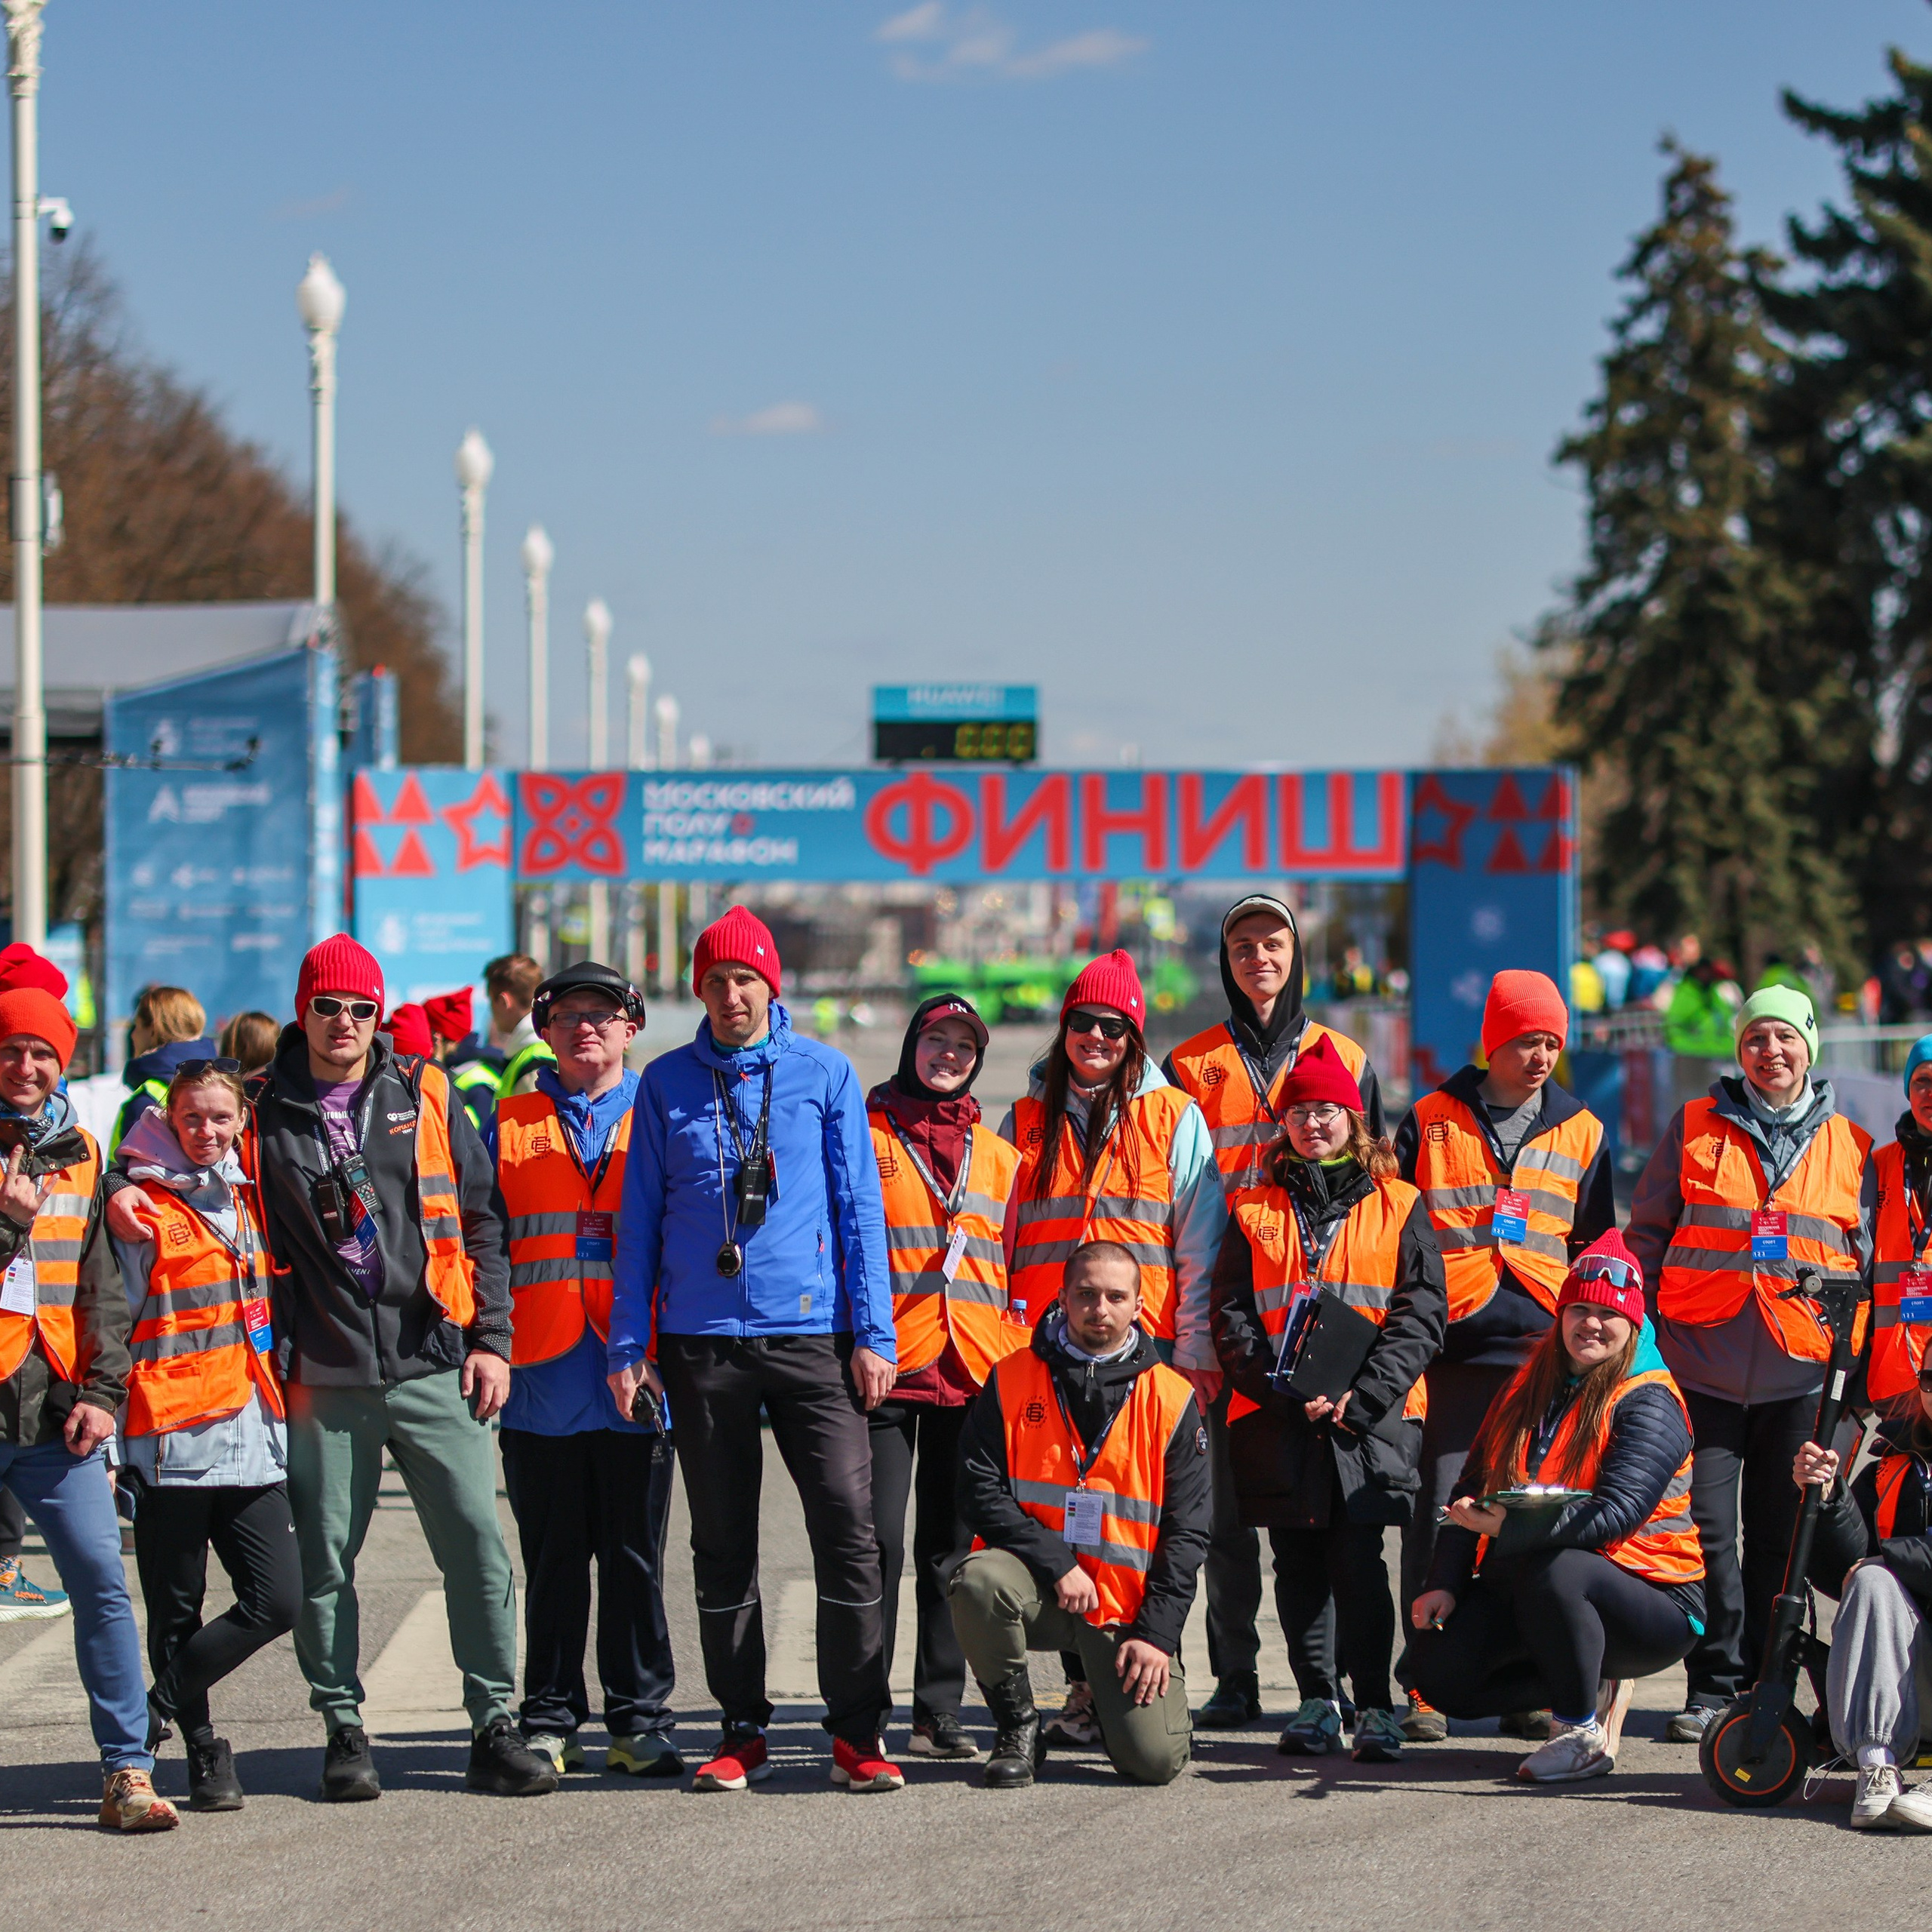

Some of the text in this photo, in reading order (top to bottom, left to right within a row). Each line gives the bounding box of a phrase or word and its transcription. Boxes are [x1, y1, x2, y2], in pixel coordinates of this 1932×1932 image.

[643, 777, 855, 810] МОСКОВСКИЙ
[643, 811, 731, 836] ПОЛУ
[865, 772, 1403, 875] ФИНИШ
[643, 838, 798, 865] МАРАФОН
[389, 1119, 417, 1135] КОМАНД
